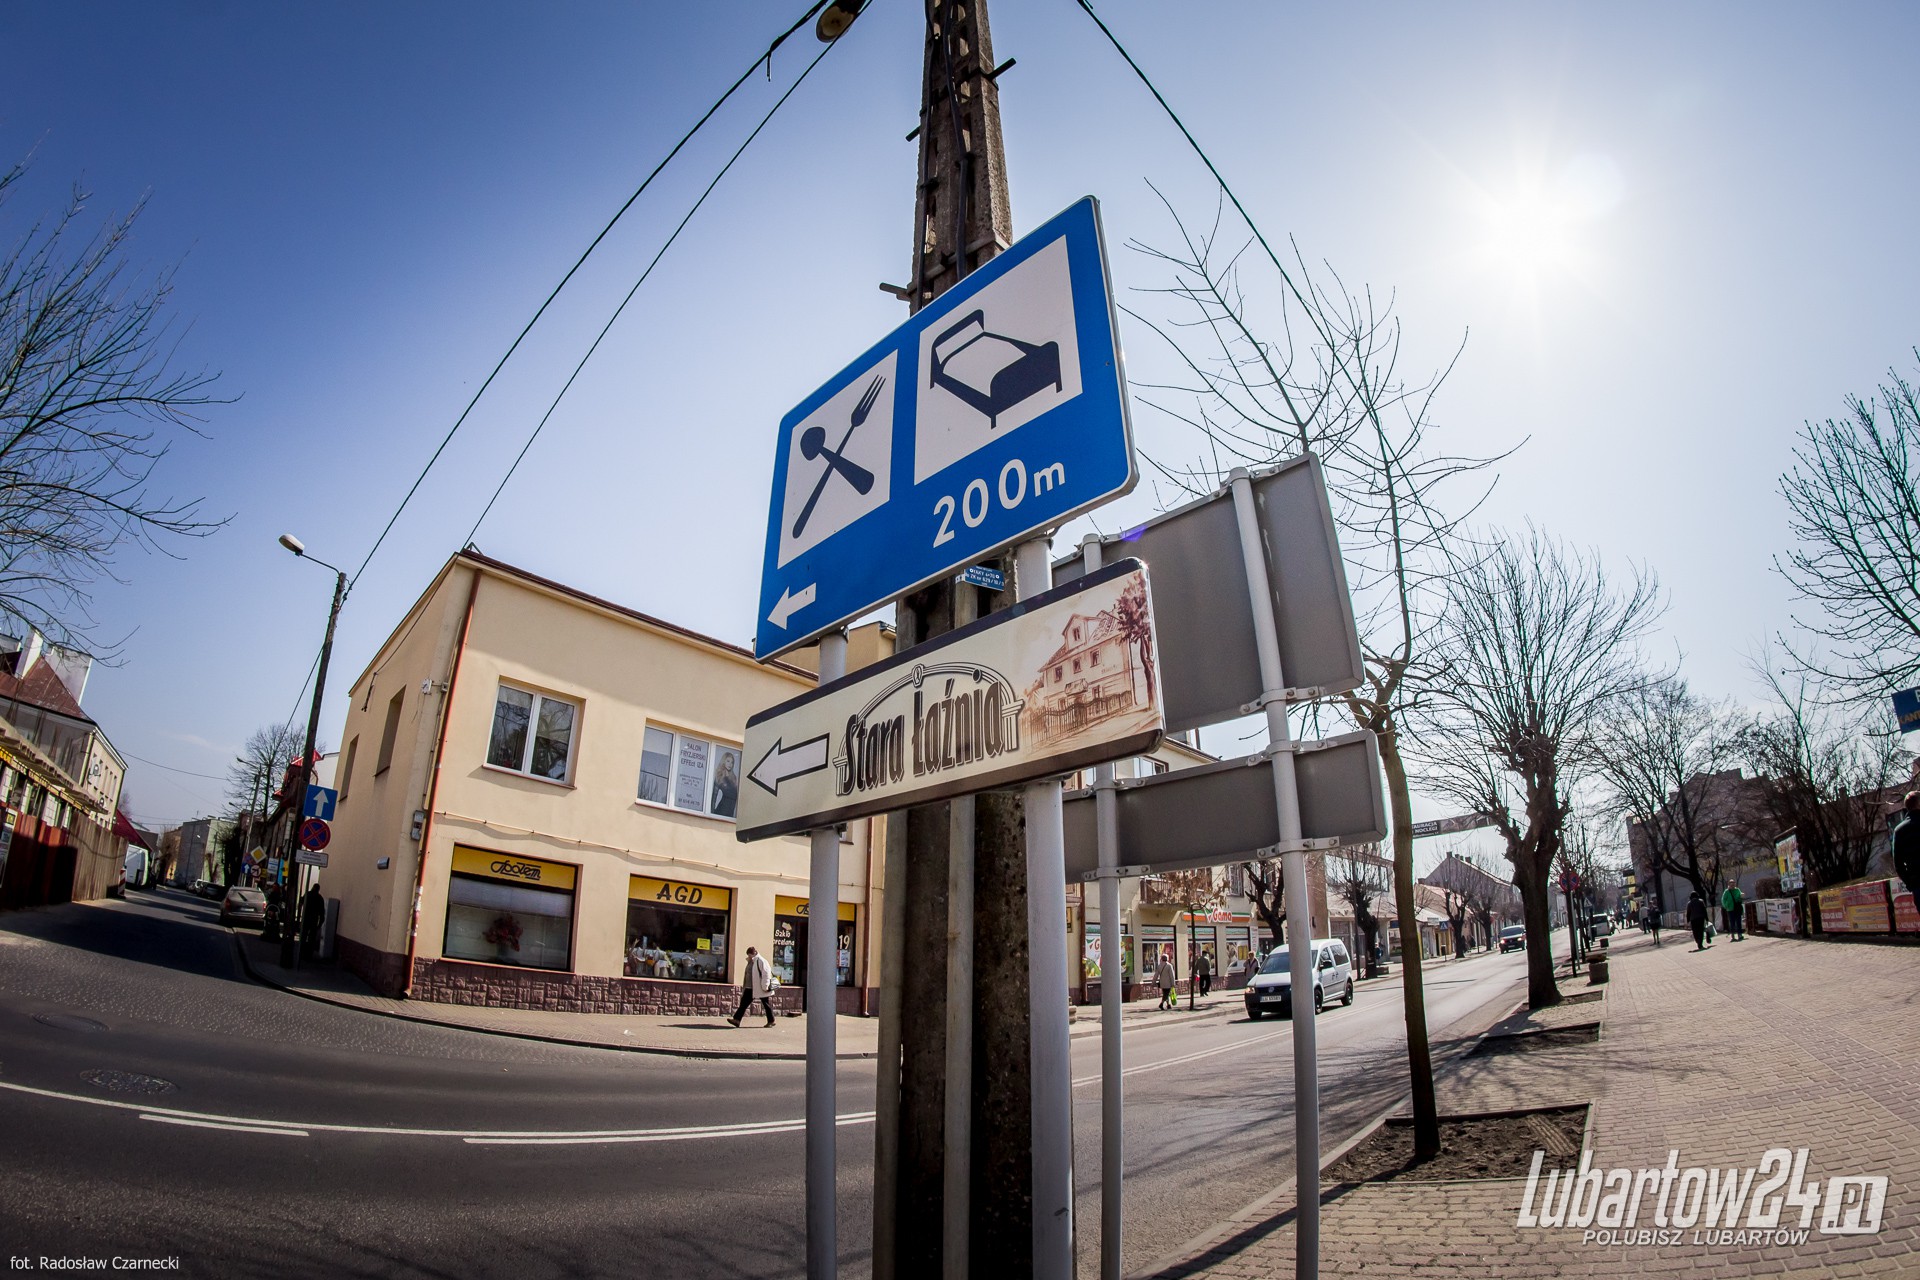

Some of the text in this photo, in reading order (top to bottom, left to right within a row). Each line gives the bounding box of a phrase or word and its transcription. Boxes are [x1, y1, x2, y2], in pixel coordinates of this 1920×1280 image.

[841, 668, 1005, 796] Stara Łaźnia
[656, 883, 703, 905] AGD
[1212, 908, 1232, 923] Gama
[773, 938, 795, 946] orcelana
[838, 934, 850, 950] 19
